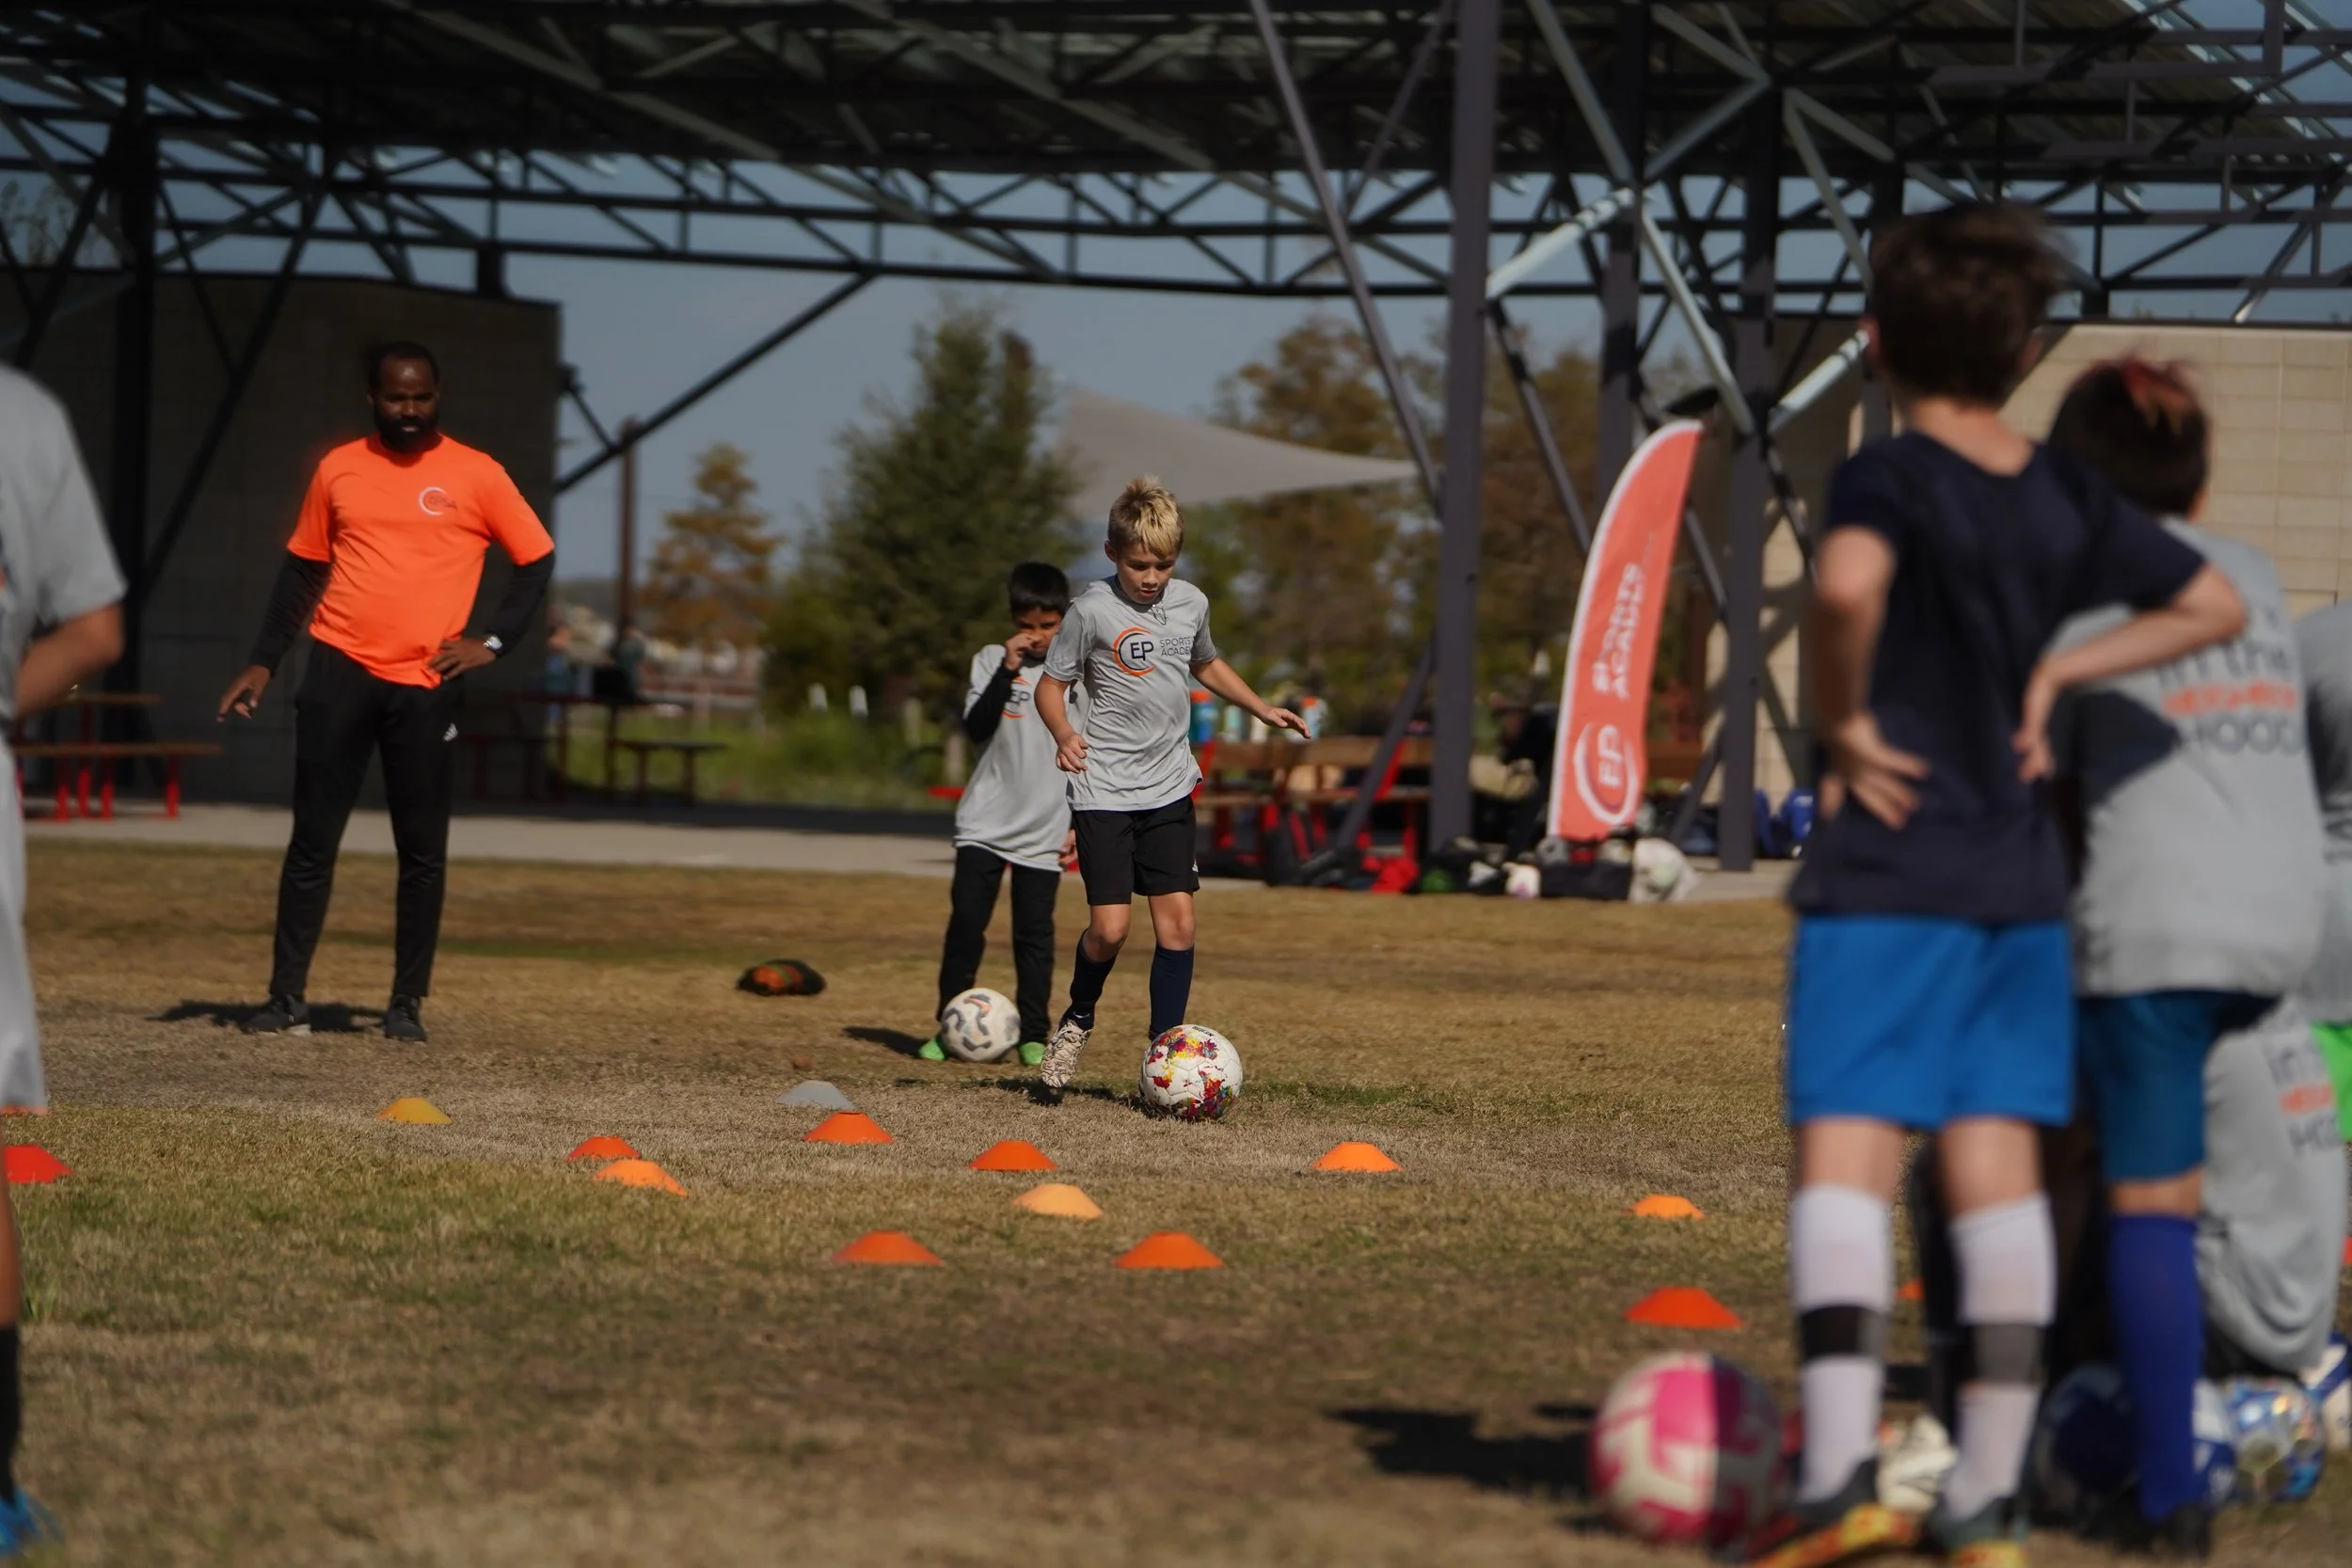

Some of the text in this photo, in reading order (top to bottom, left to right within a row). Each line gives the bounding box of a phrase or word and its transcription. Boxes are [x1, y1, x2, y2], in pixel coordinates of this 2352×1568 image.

[1159, 636, 1192, 648] SPORTS
[1130, 641, 1154, 661] EP
[1160, 646, 1192, 657] ACADE
